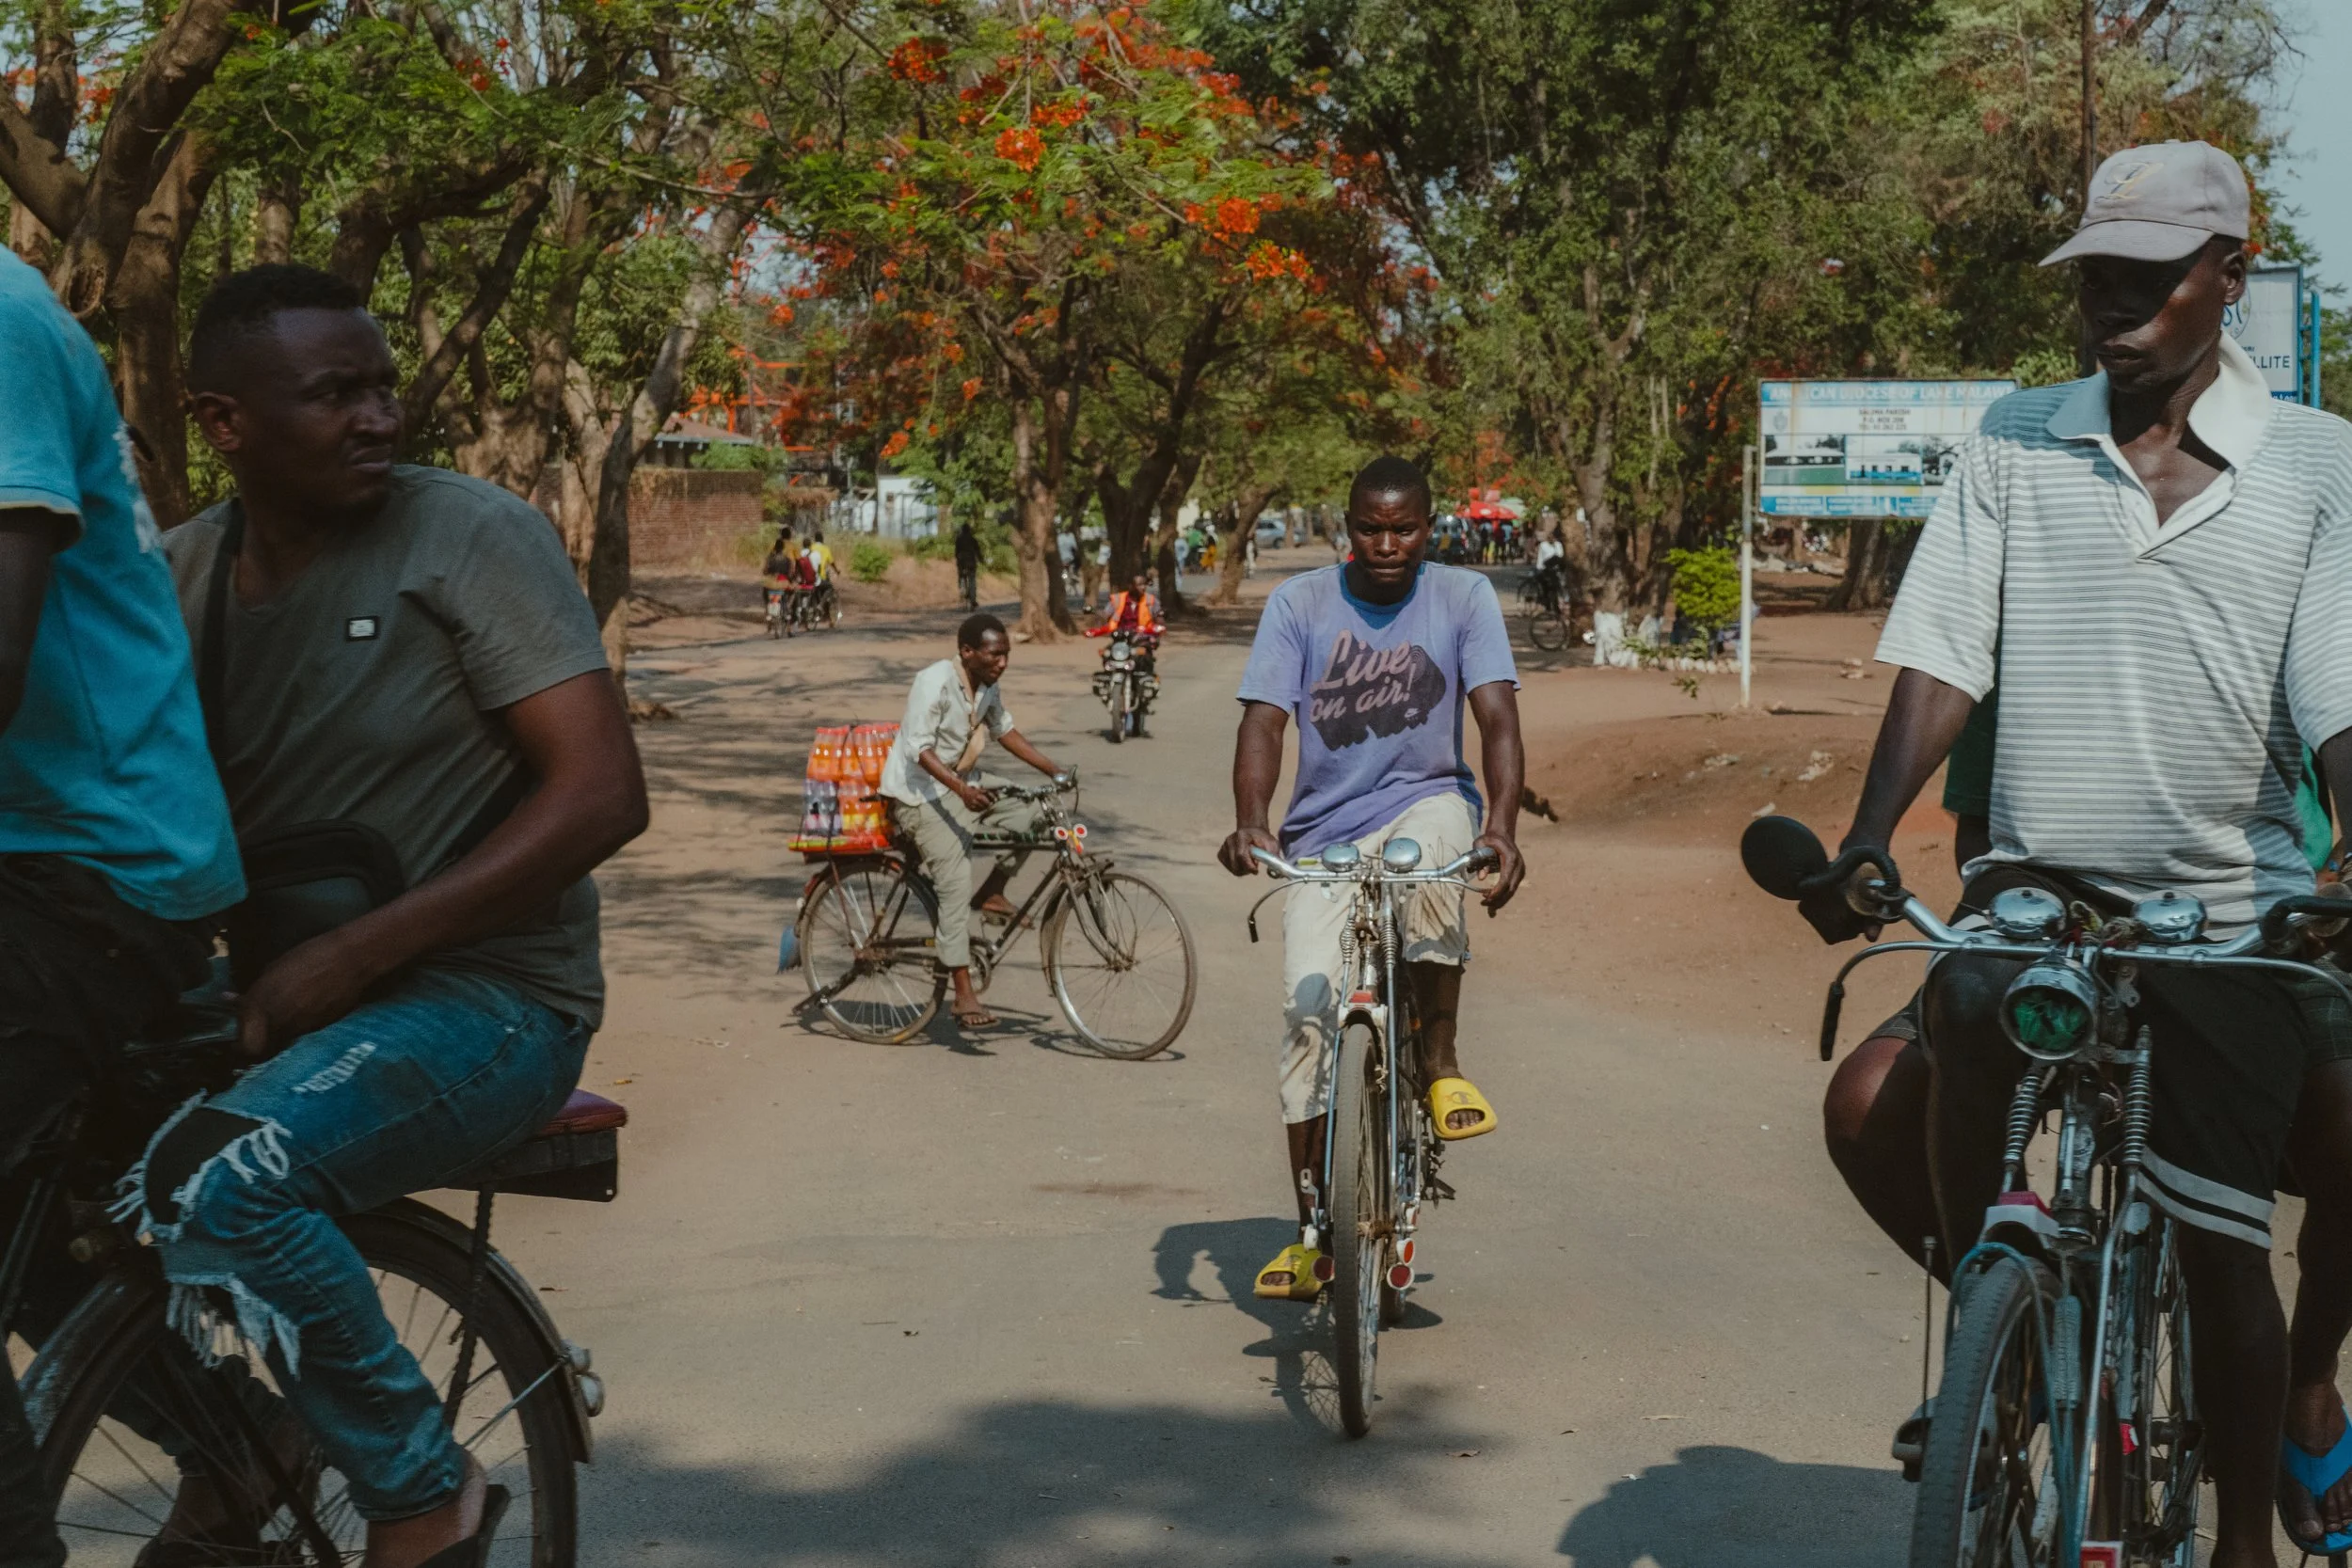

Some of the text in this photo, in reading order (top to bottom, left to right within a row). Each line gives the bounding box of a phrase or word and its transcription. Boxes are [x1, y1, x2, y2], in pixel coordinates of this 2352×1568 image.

[2249, 355, 2290, 369] LLITE
[1900, 387, 1916, 399] OF
[1920, 387, 1953, 399] LAKE
[1309, 629, 1411, 693] Live
[1309, 662, 1417, 722] on air!
